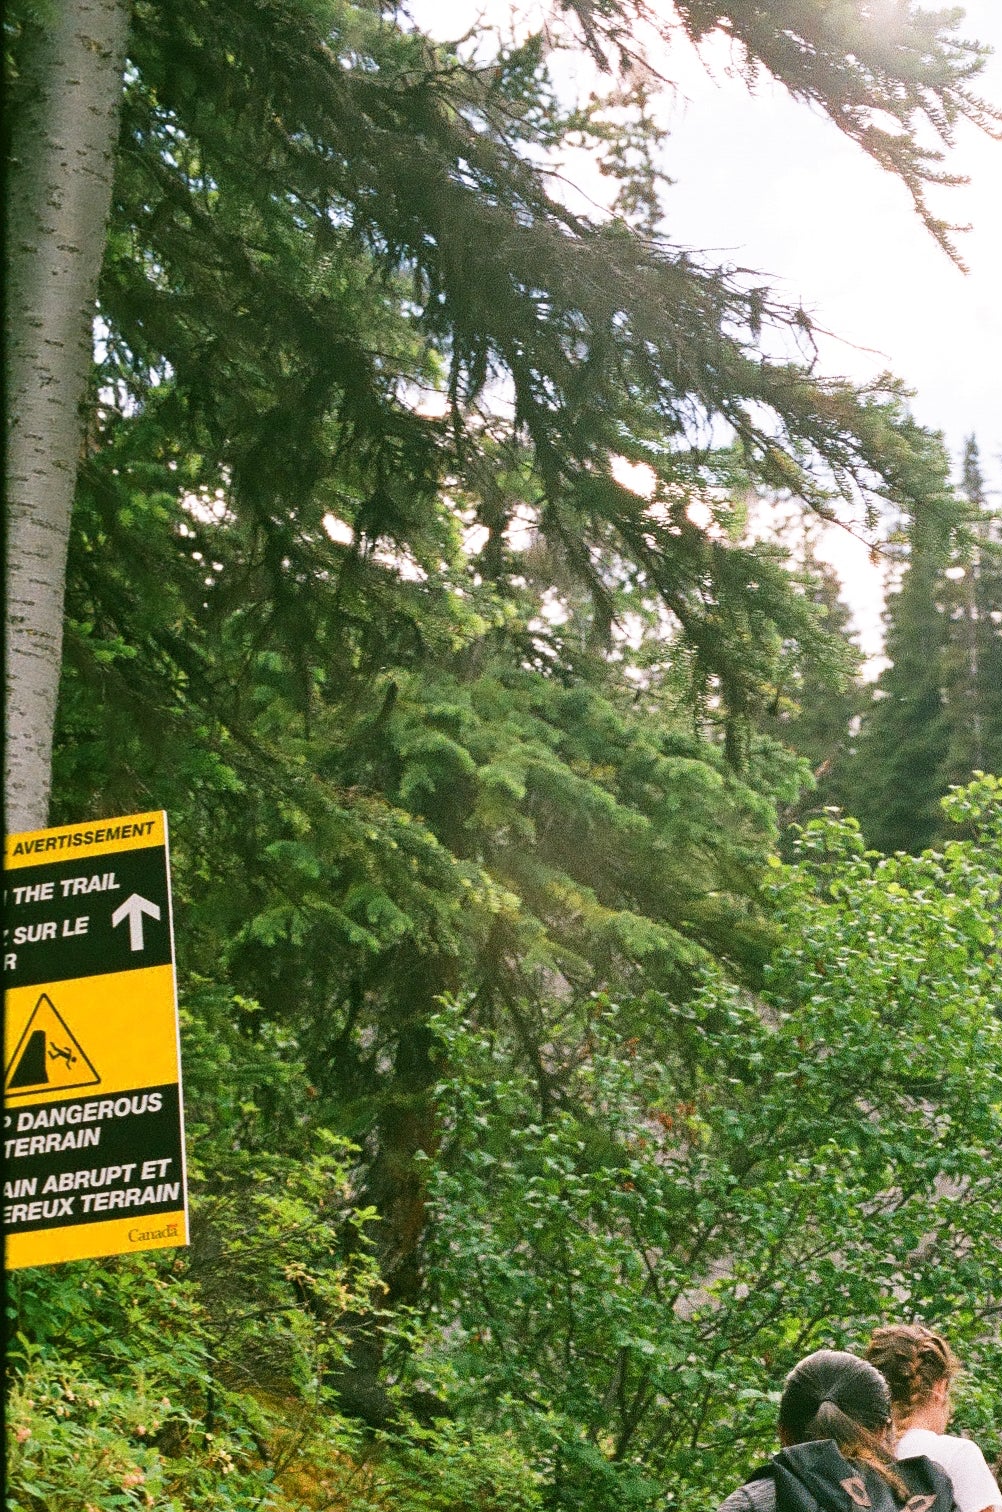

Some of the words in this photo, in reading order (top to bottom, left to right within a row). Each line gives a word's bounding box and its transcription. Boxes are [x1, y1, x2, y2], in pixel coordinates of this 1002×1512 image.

[12, 821, 156, 857] AVERTISSEMENT
[12, 882, 55, 905] THE
[60, 872, 121, 897] TRAIL
[13, 921, 58, 945] SUR
[62, 916, 90, 938] LE
[16, 1092, 163, 1132] DANGEROUS
[3, 1127, 102, 1159] TERRAIN
[41, 1163, 137, 1194] ABRUPT
[140, 1158, 173, 1181] ET
[80, 1182, 181, 1213] TERRAIN
[128, 1223, 178, 1242] Canada
